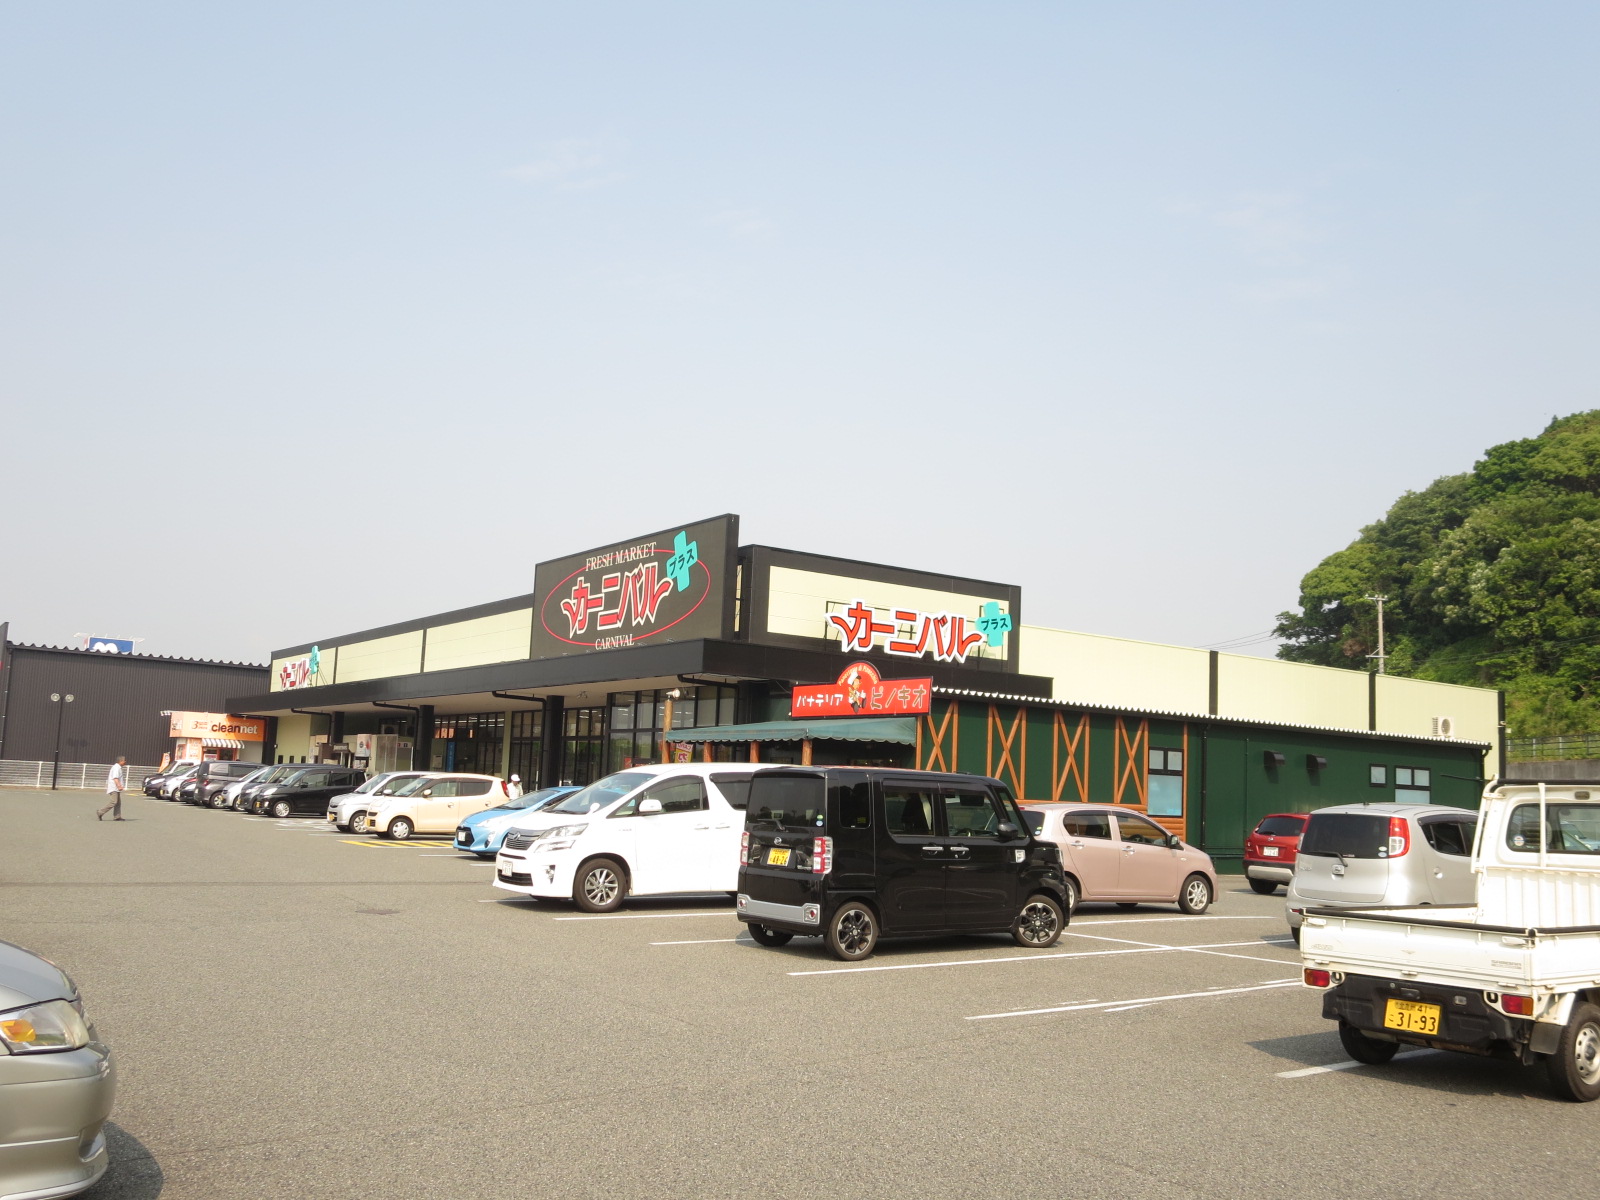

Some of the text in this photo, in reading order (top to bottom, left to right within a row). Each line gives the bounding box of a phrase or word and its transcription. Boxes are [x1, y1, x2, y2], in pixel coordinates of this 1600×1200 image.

[585, 542, 657, 572] FRESH MARKET
[669, 549, 695, 576] プラス
[560, 562, 674, 639] カーニバル
[827, 600, 985, 661] カーニバル
[980, 617, 1009, 632] プラス
[595, 634, 635, 650] CARNIVAL
[870, 684, 927, 710] ピノキオ
[1396, 1011, 1437, 1032] 31-93
